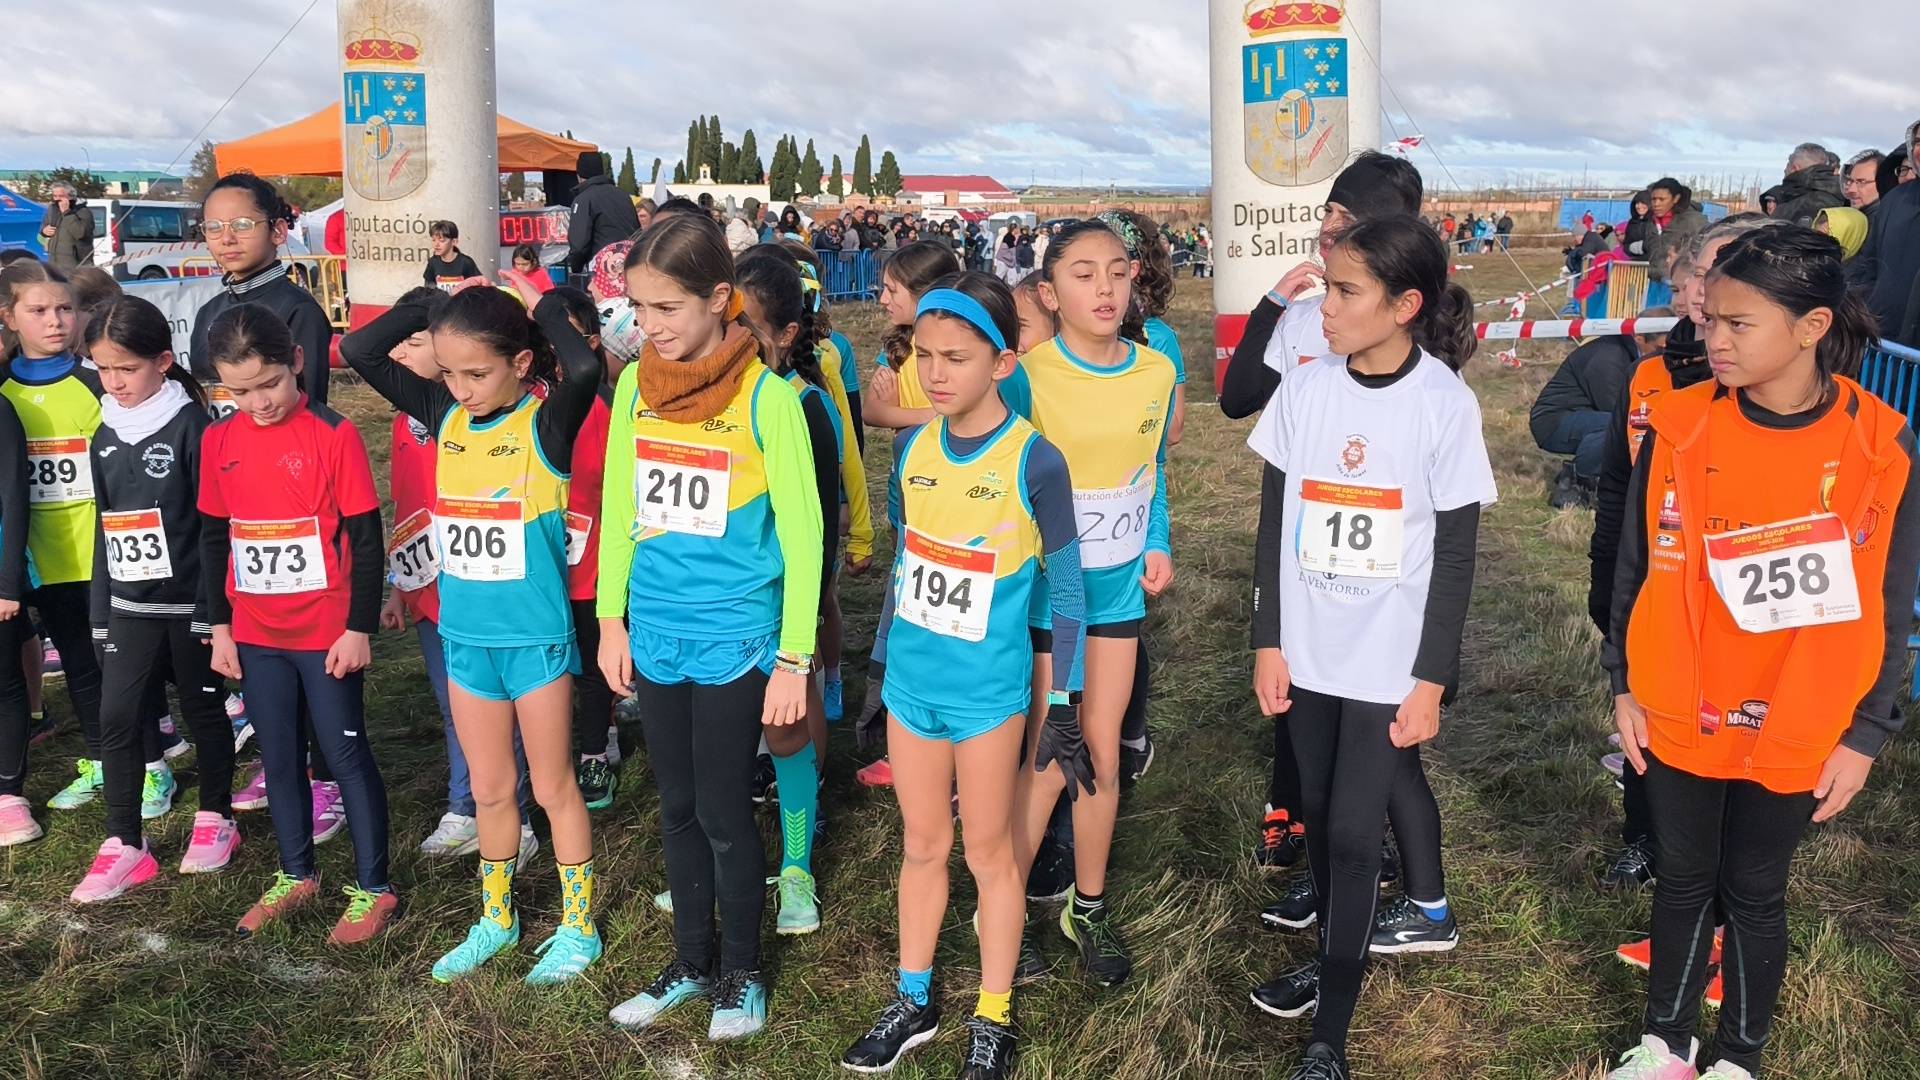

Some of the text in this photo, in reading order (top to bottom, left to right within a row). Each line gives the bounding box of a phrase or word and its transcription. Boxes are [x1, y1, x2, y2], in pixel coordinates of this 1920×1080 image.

[1227, 240, 1242, 258] de
[646, 468, 710, 510] 210
[447, 523, 507, 559] 206
[1078, 504, 1146, 544] 208
[1326, 511, 1373, 551] 18
[1731, 523, 1812, 545] JUEGOS ESCOLARES
[245, 544, 307, 575] 373
[396, 533, 434, 576] 377
[912, 564, 972, 614] 194
[1308, 575, 1370, 597] VENTORRO
[1738, 552, 1830, 606] 258
